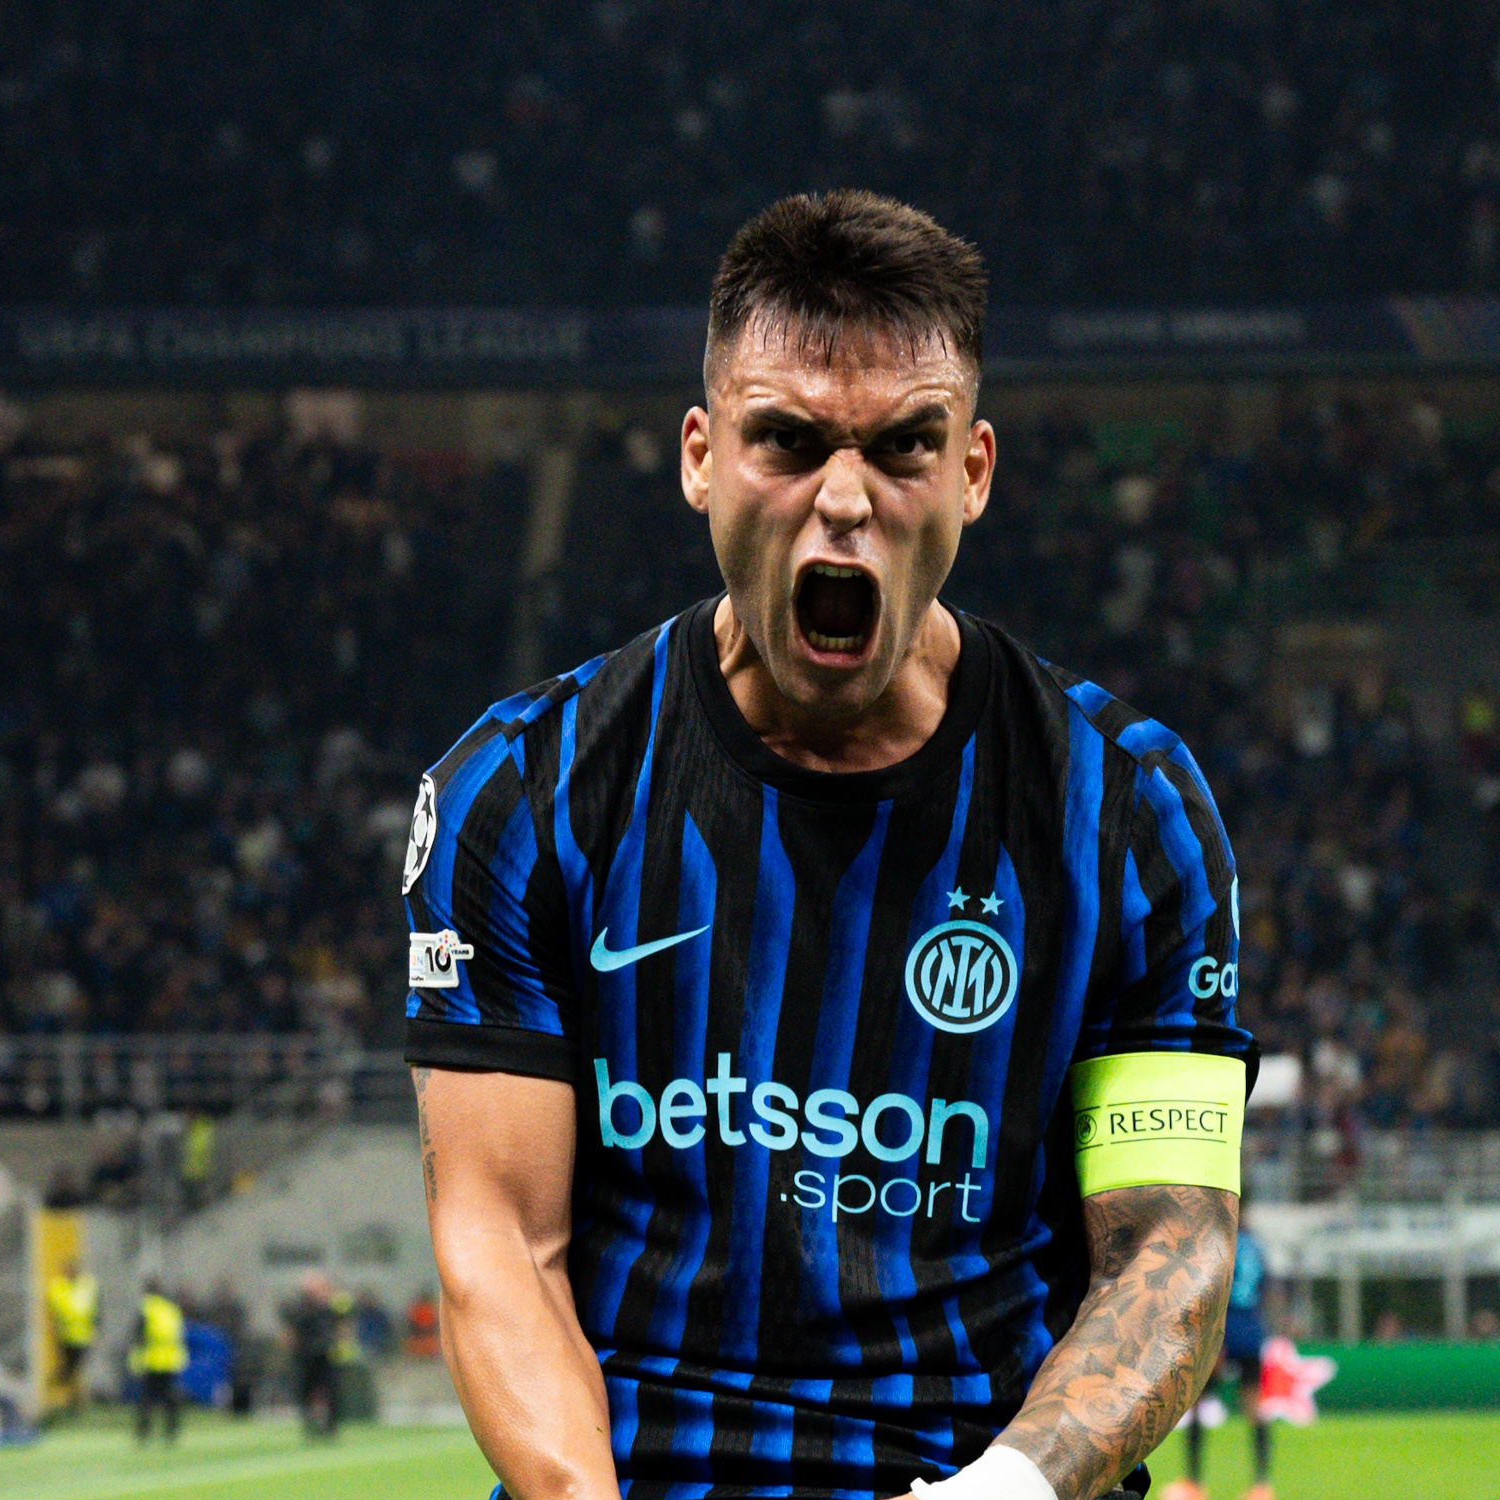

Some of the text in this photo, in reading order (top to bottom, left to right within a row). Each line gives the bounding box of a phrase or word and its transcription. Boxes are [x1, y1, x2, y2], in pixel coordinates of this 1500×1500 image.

[425, 946, 451, 972] 10
[1188, 956, 1239, 999] Ga
[593, 1052, 989, 1169] betsson
[1109, 1108, 1228, 1136] RESPECT
